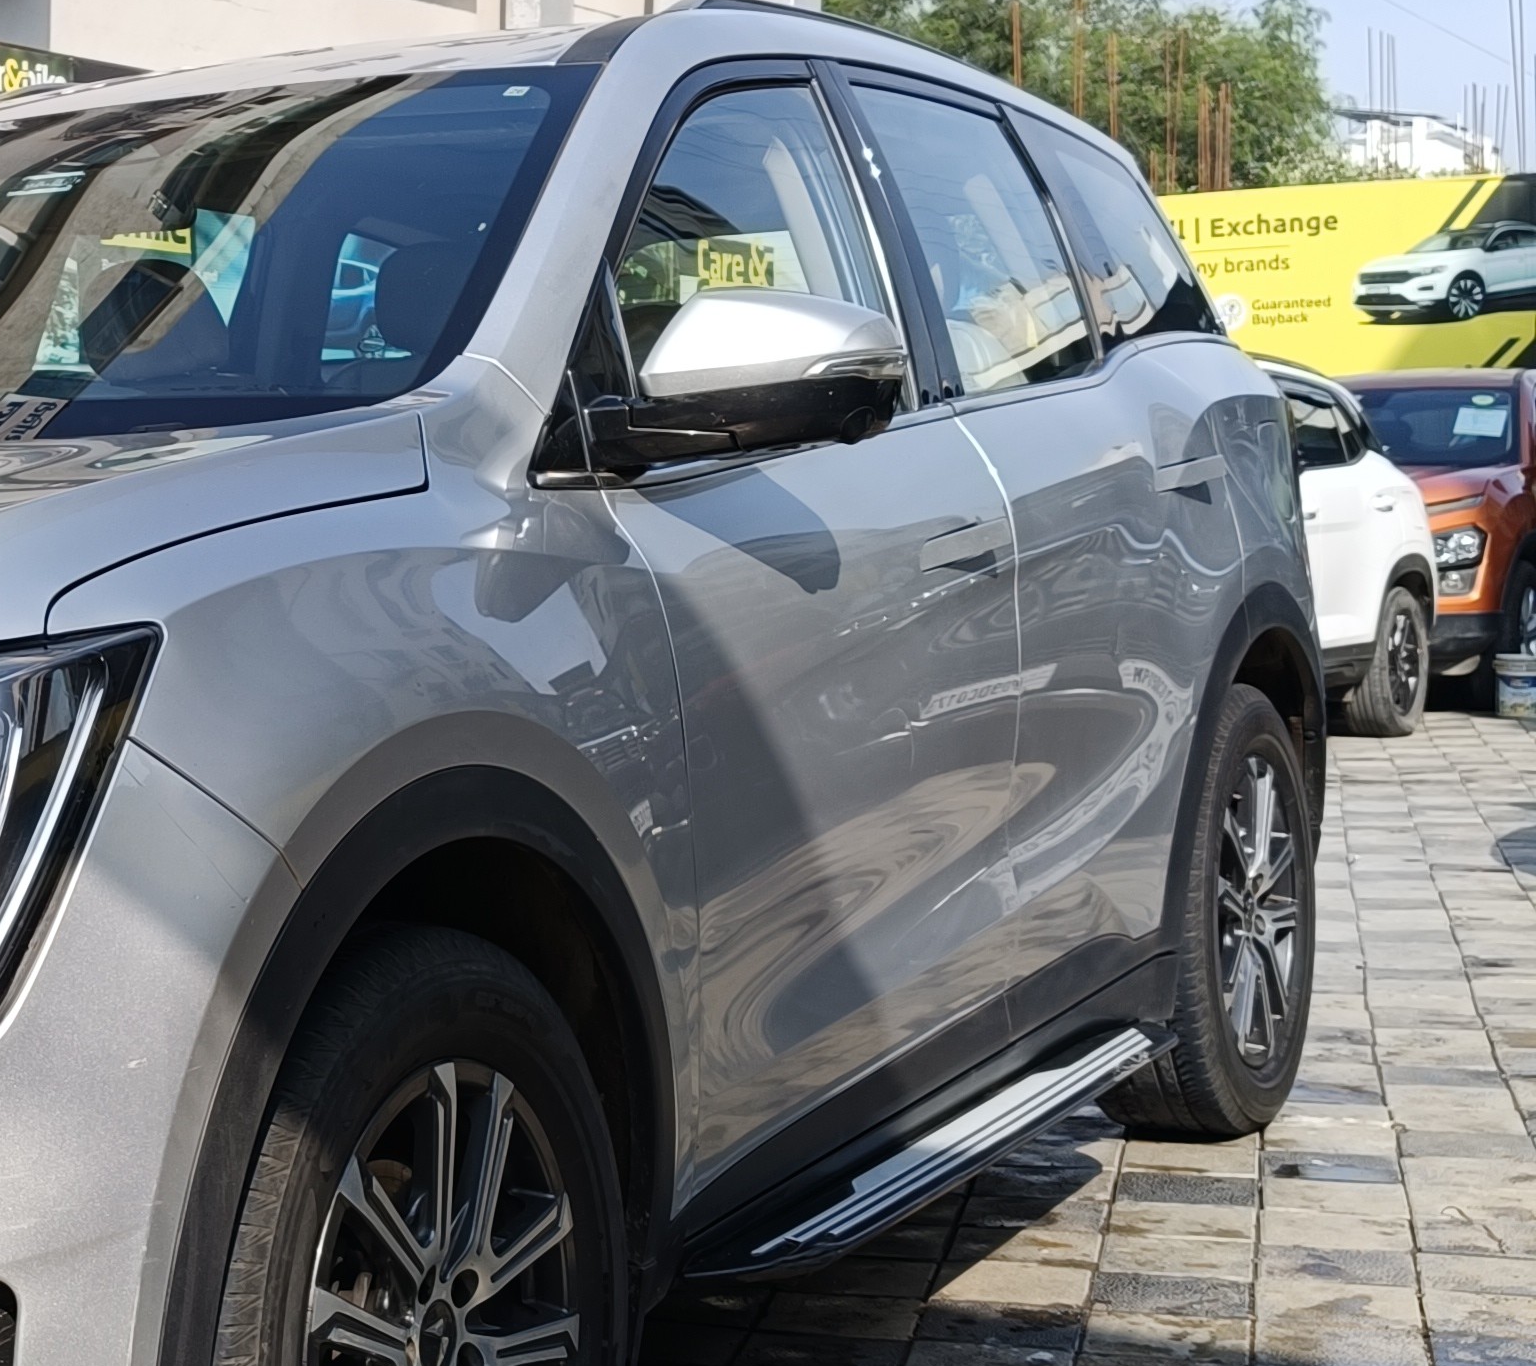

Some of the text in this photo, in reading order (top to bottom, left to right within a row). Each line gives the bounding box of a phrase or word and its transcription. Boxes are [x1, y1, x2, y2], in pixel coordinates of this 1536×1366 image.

[1210, 212, 1339, 238] Exchange
[697, 238, 745, 284] Care
[1224, 253, 1291, 273] brands
[1251, 296, 1332, 311] Guaranteed
[1251, 311, 1309, 327] Buyback
